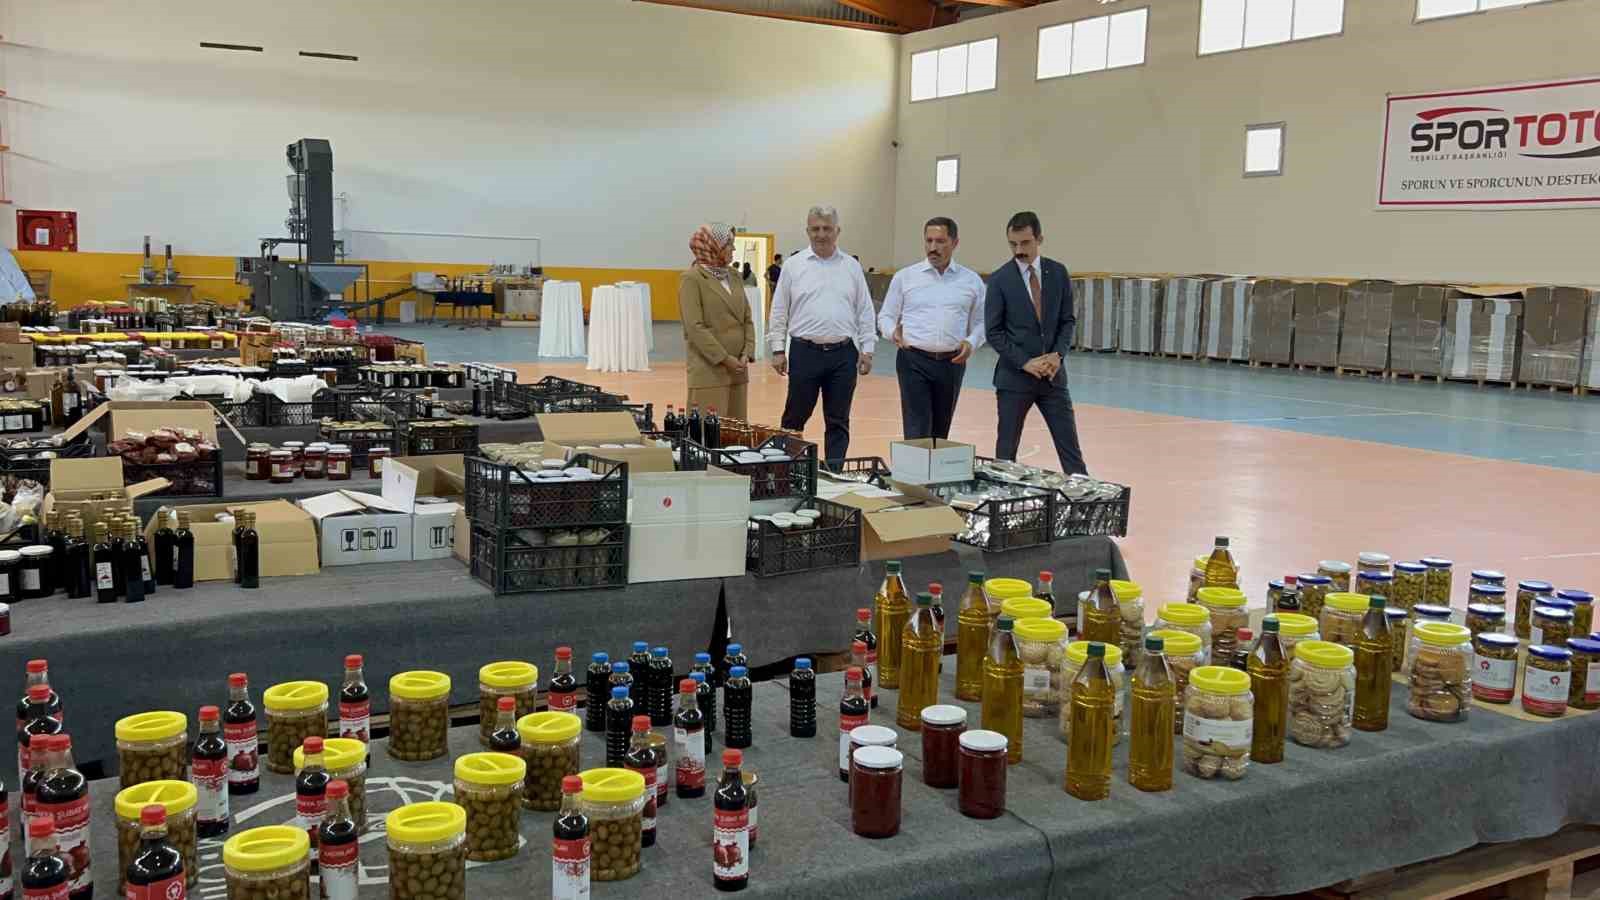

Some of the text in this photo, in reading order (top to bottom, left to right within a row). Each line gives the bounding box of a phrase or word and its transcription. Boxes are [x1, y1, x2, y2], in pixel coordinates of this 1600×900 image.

[1401, 173, 1600, 191] SPORUN VE SPORCUNUN DESTEK
